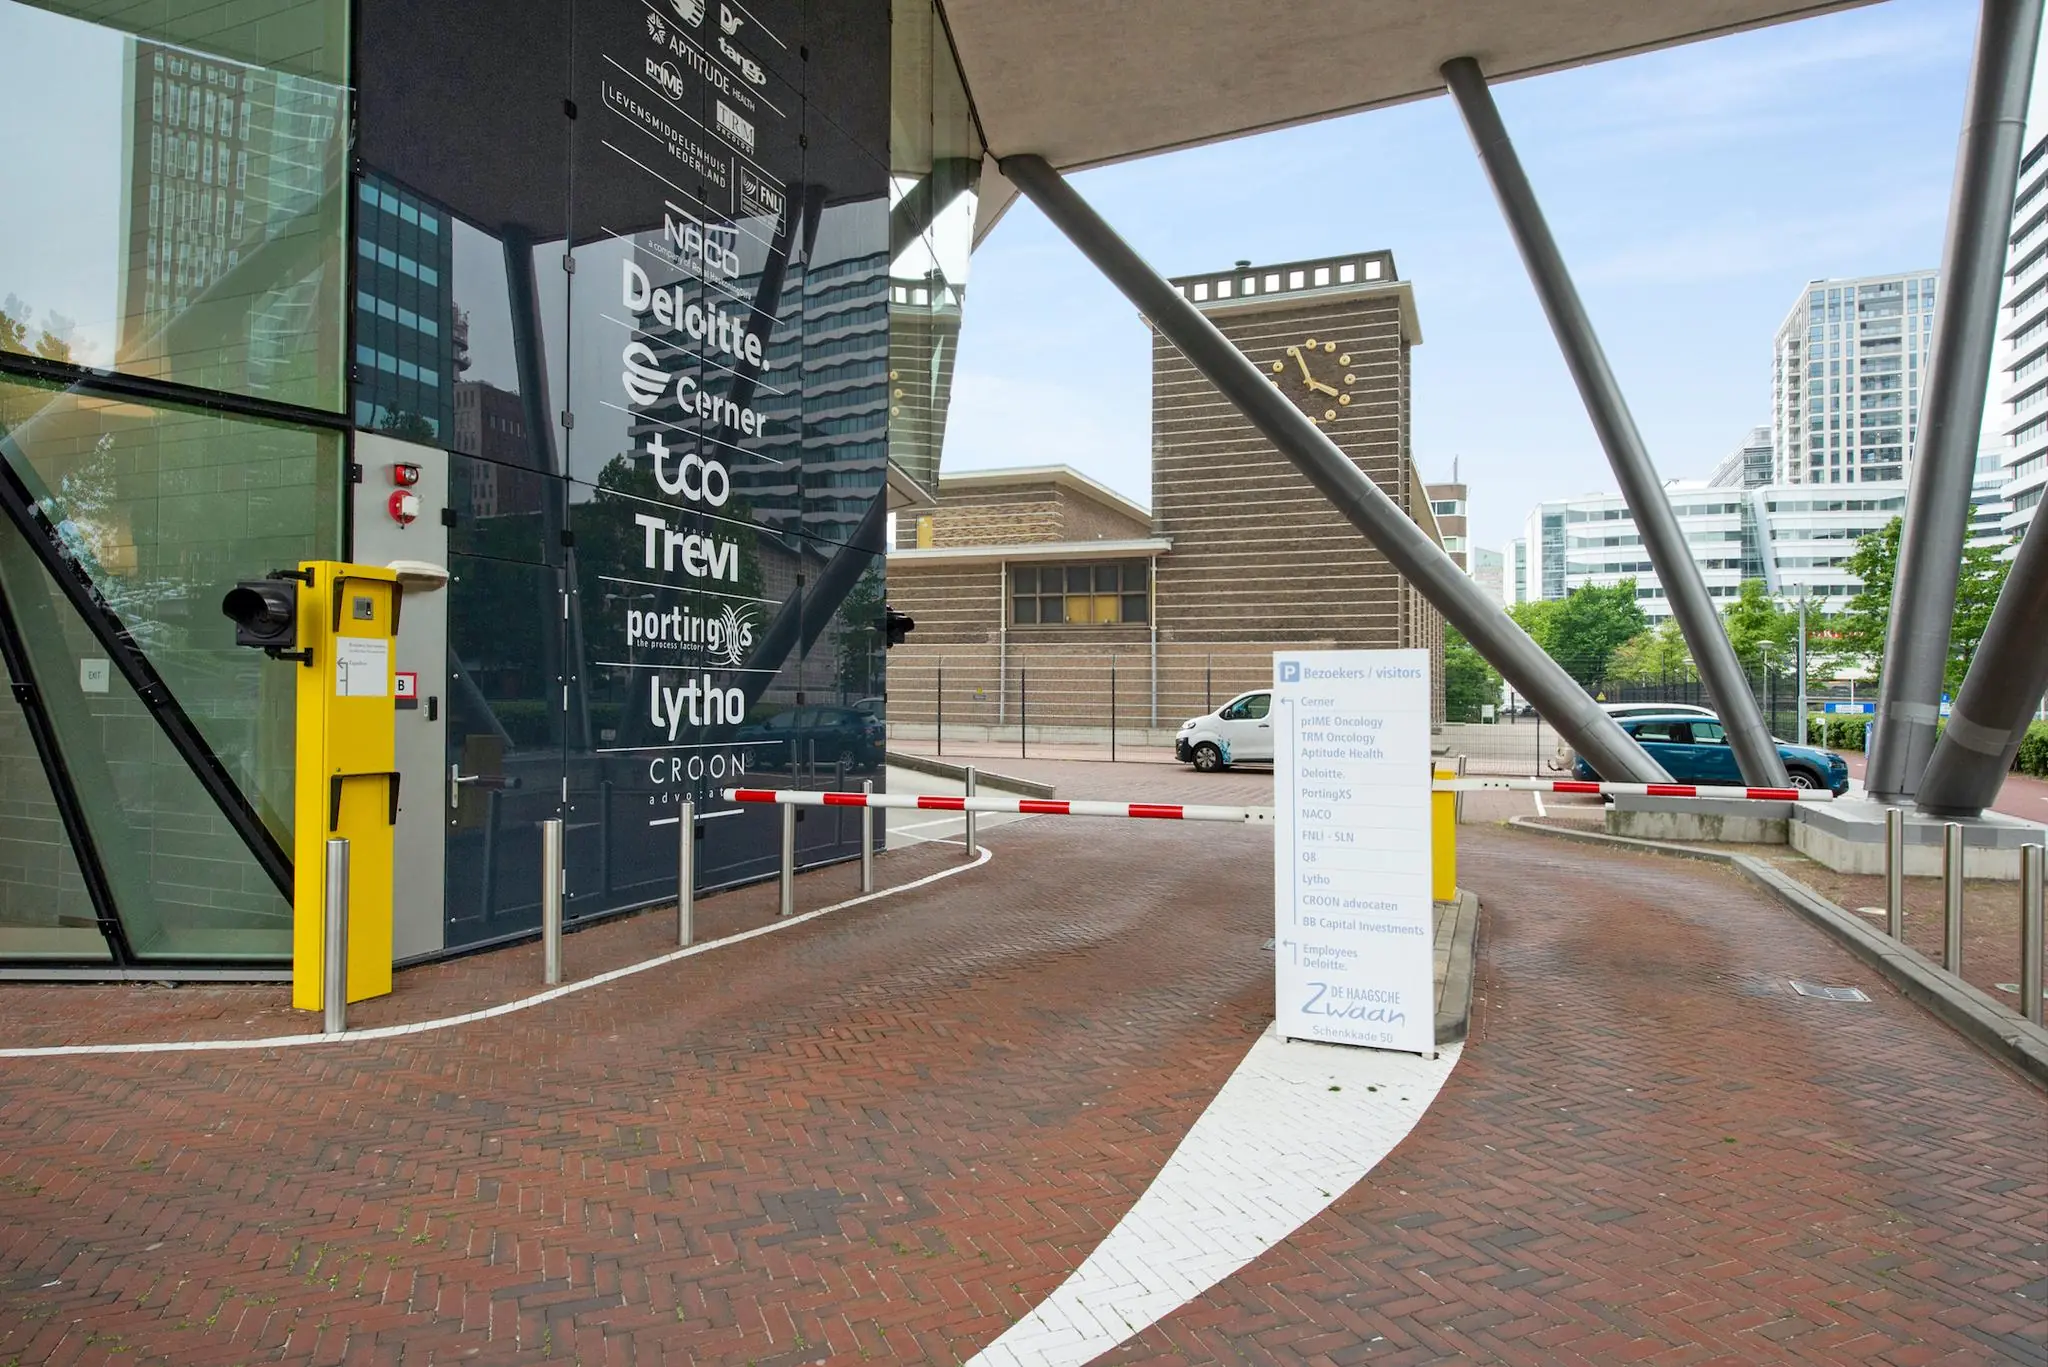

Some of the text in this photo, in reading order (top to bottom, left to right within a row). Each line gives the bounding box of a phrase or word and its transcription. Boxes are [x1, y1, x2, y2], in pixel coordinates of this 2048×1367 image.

[718, 36, 766, 85] tango
[670, 35, 755, 112] APTITUDE HEALTH
[610, 86, 726, 174] LEVENSMIDDELENHUIS
[720, 104, 752, 145] TRM
[668, 142, 726, 188] NEDERLAND
[761, 185, 782, 214] FNLI
[664, 212, 740, 279] NACO
[622, 259, 770, 371] Deloitte.
[677, 376, 766, 438] Cerner
[637, 639, 704, 652] the process factory
[88, 671, 104, 680] EXIT
[1304, 668, 1364, 680] Bezoekers
[1376, 667, 1422, 679] visitors
[398, 680, 404, 690] B
[651, 674, 744, 741] lytho
[1301, 696, 1335, 707] Cerner
[1301, 716, 1383, 729] prIME Oncology
[1302, 732, 1376, 746] TRM Oncology
[1301, 748, 1384, 760] Aptitude Health
[650, 752, 744, 784] CROON
[1302, 788, 1352, 801] PortingXS
[1302, 808, 1332, 820] NACO
[1335, 831, 1354, 842] SLN
[1302, 874, 1330, 884] Lytho
[1302, 895, 1398, 911] CROON advocaten
[1320, 918, 1356, 930] Capital
[1359, 922, 1424, 936] Investments
[1303, 944, 1358, 958] Employees
[1303, 958, 1348, 970] Deloitte.
[1331, 986, 1400, 1004] DE HAAGSCHE
[1302, 982, 1406, 1028] Zwaan
[1312, 1024, 1393, 1043] Schenkkade 50
